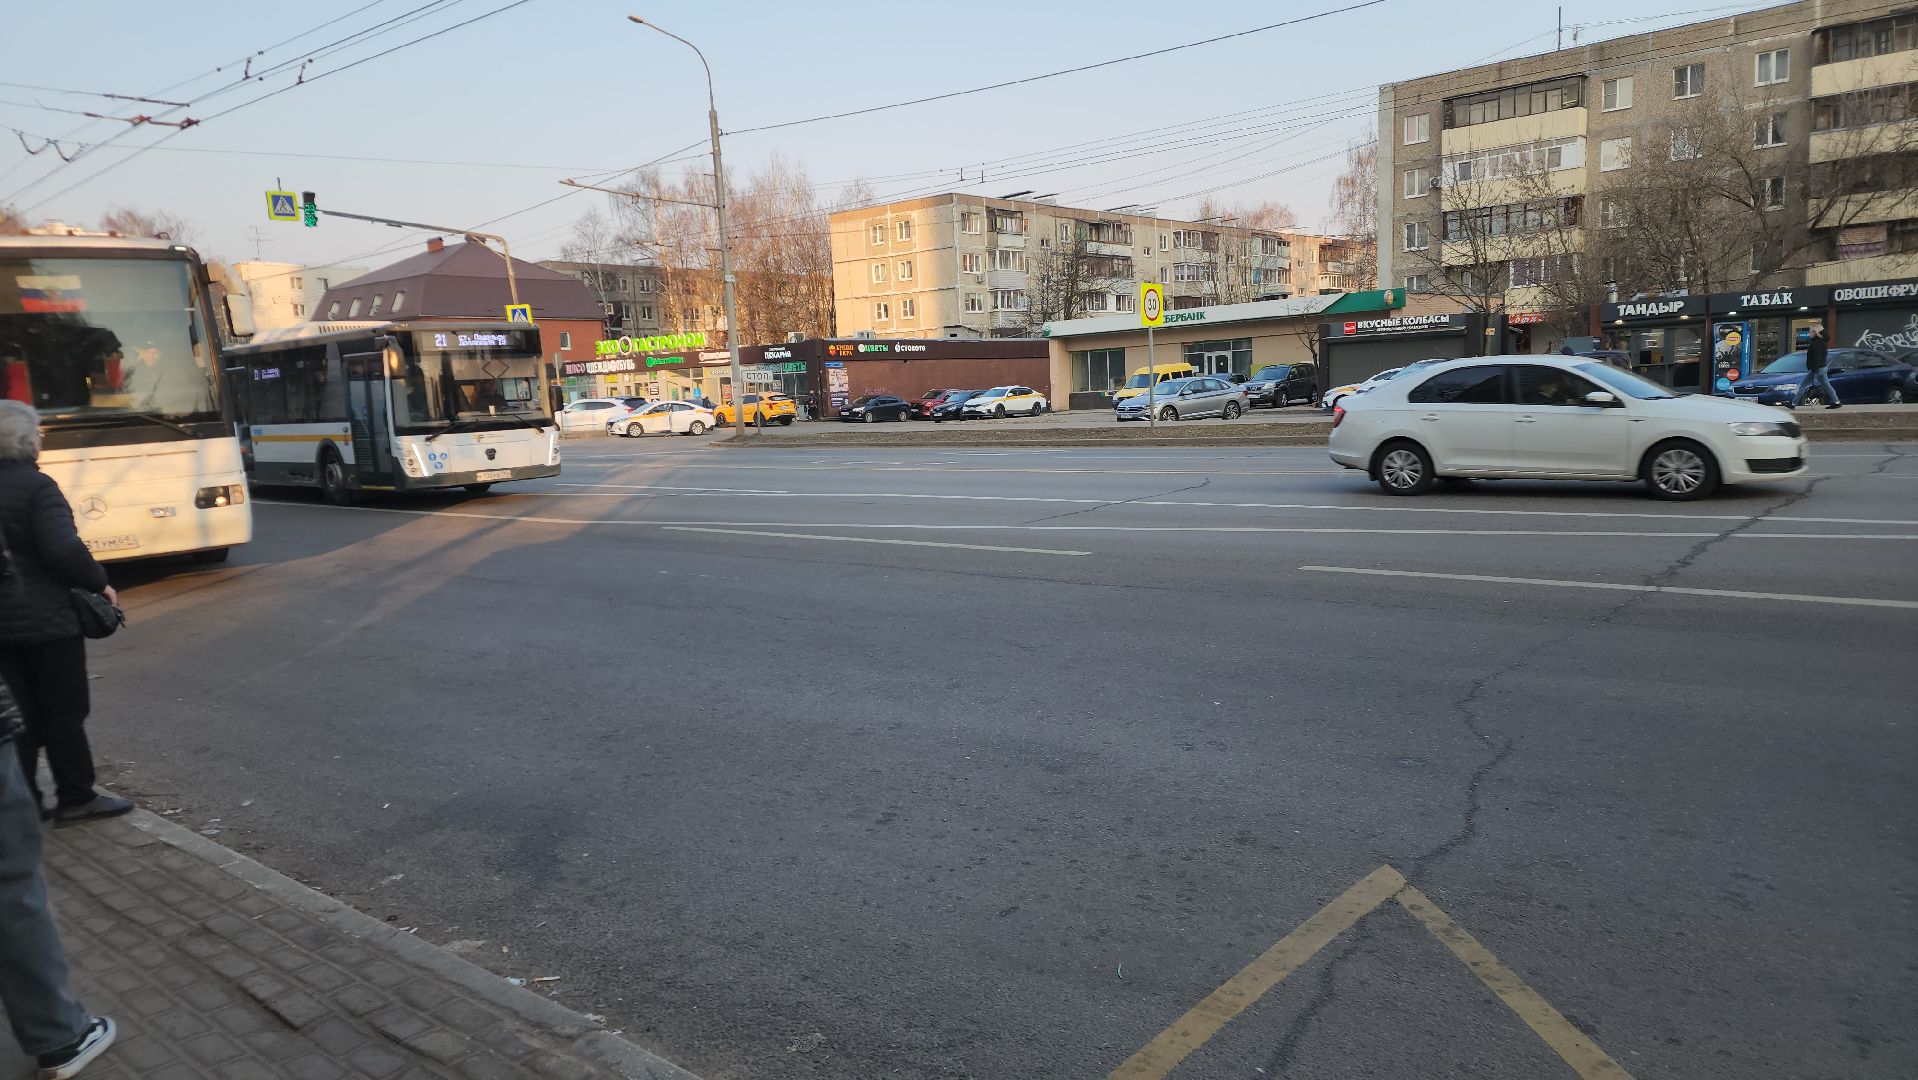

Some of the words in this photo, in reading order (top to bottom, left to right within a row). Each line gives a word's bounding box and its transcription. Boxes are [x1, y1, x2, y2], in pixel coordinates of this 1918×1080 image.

[1147, 298, 1157, 311] 30
[1741, 292, 1793, 307] ТАБАК
[1617, 300, 1685, 317] ТАНДЫР
[1163, 311, 1206, 324] БЕРБАНК
[1357, 318, 1401, 329] ВКУСНЫЕ
[1402, 314, 1450, 325] КОЛБАСЫ
[434, 333, 447, 347] 21
[631, 332, 706, 352] ГАСТРОНОМ
[864, 344, 889, 353] ЦВЕТЫ
[746, 372, 769, 380] СТОП
